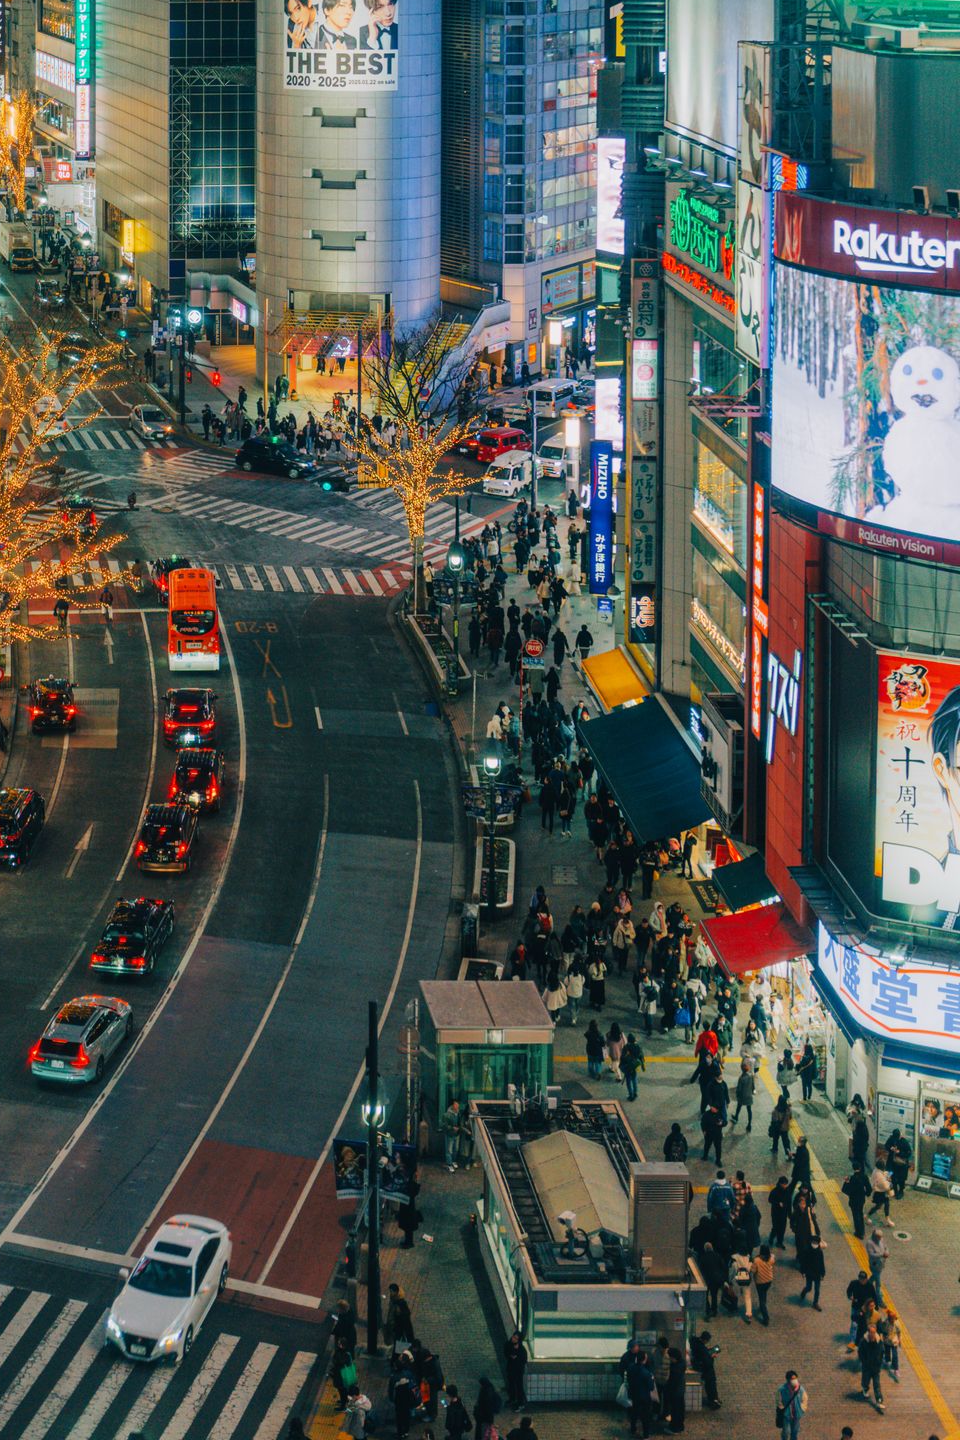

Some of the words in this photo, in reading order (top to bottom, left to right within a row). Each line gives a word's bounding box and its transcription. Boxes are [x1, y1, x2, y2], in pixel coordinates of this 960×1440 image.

[286, 52, 328, 74] THE
[336, 53, 396, 75] BEST
[286, 75, 310, 86] 2020
[318, 76, 346, 87] 2025
[598, 454, 608, 499] MIZUHO
[595, 533, 605, 582] みずほ銀行
[858, 527, 899, 548] Rakuten
[900, 539, 935, 556] Vision
[891, 746, 926, 833] 十周年
